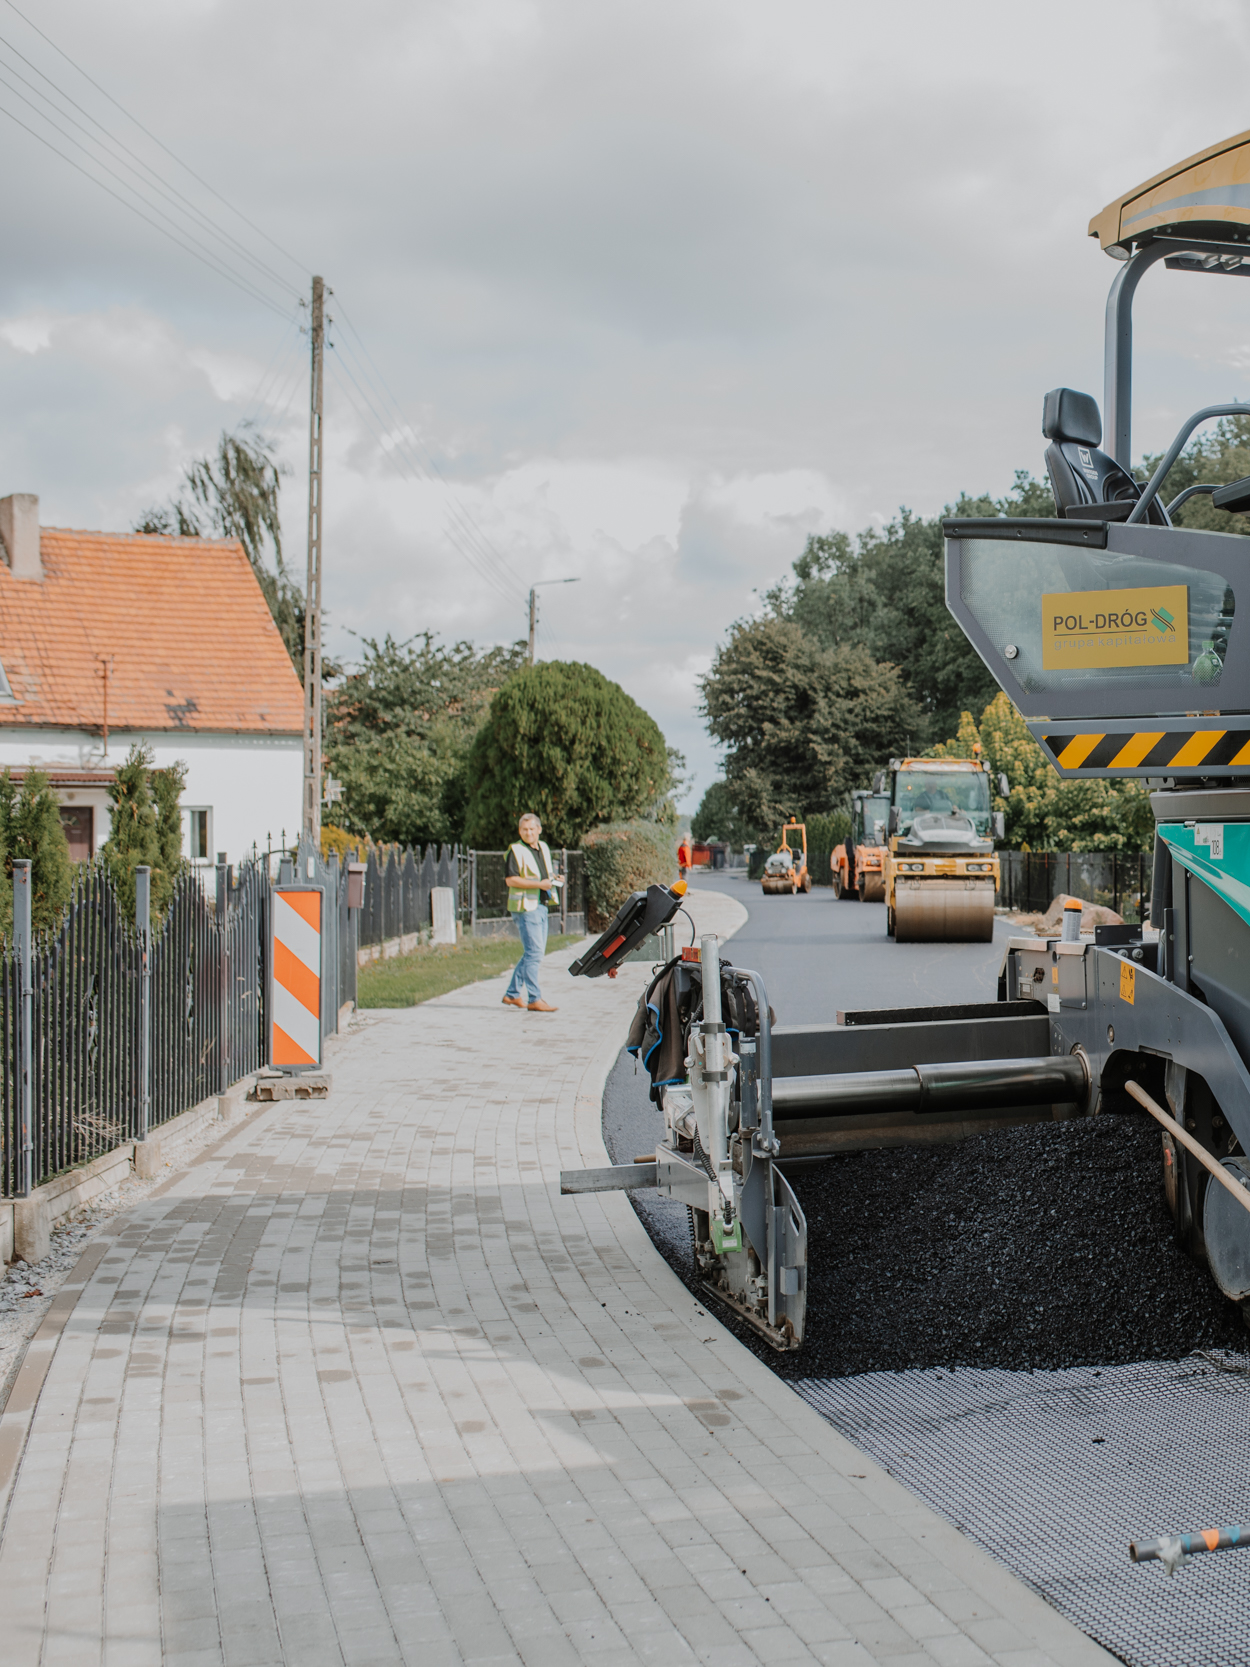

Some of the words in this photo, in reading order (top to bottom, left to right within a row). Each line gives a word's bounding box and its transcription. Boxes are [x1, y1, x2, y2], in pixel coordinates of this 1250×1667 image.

[1053, 608, 1148, 631] POL-DRÓG
[1054, 637, 1095, 651] grupa
[1097, 633, 1177, 648] kapitałowa
